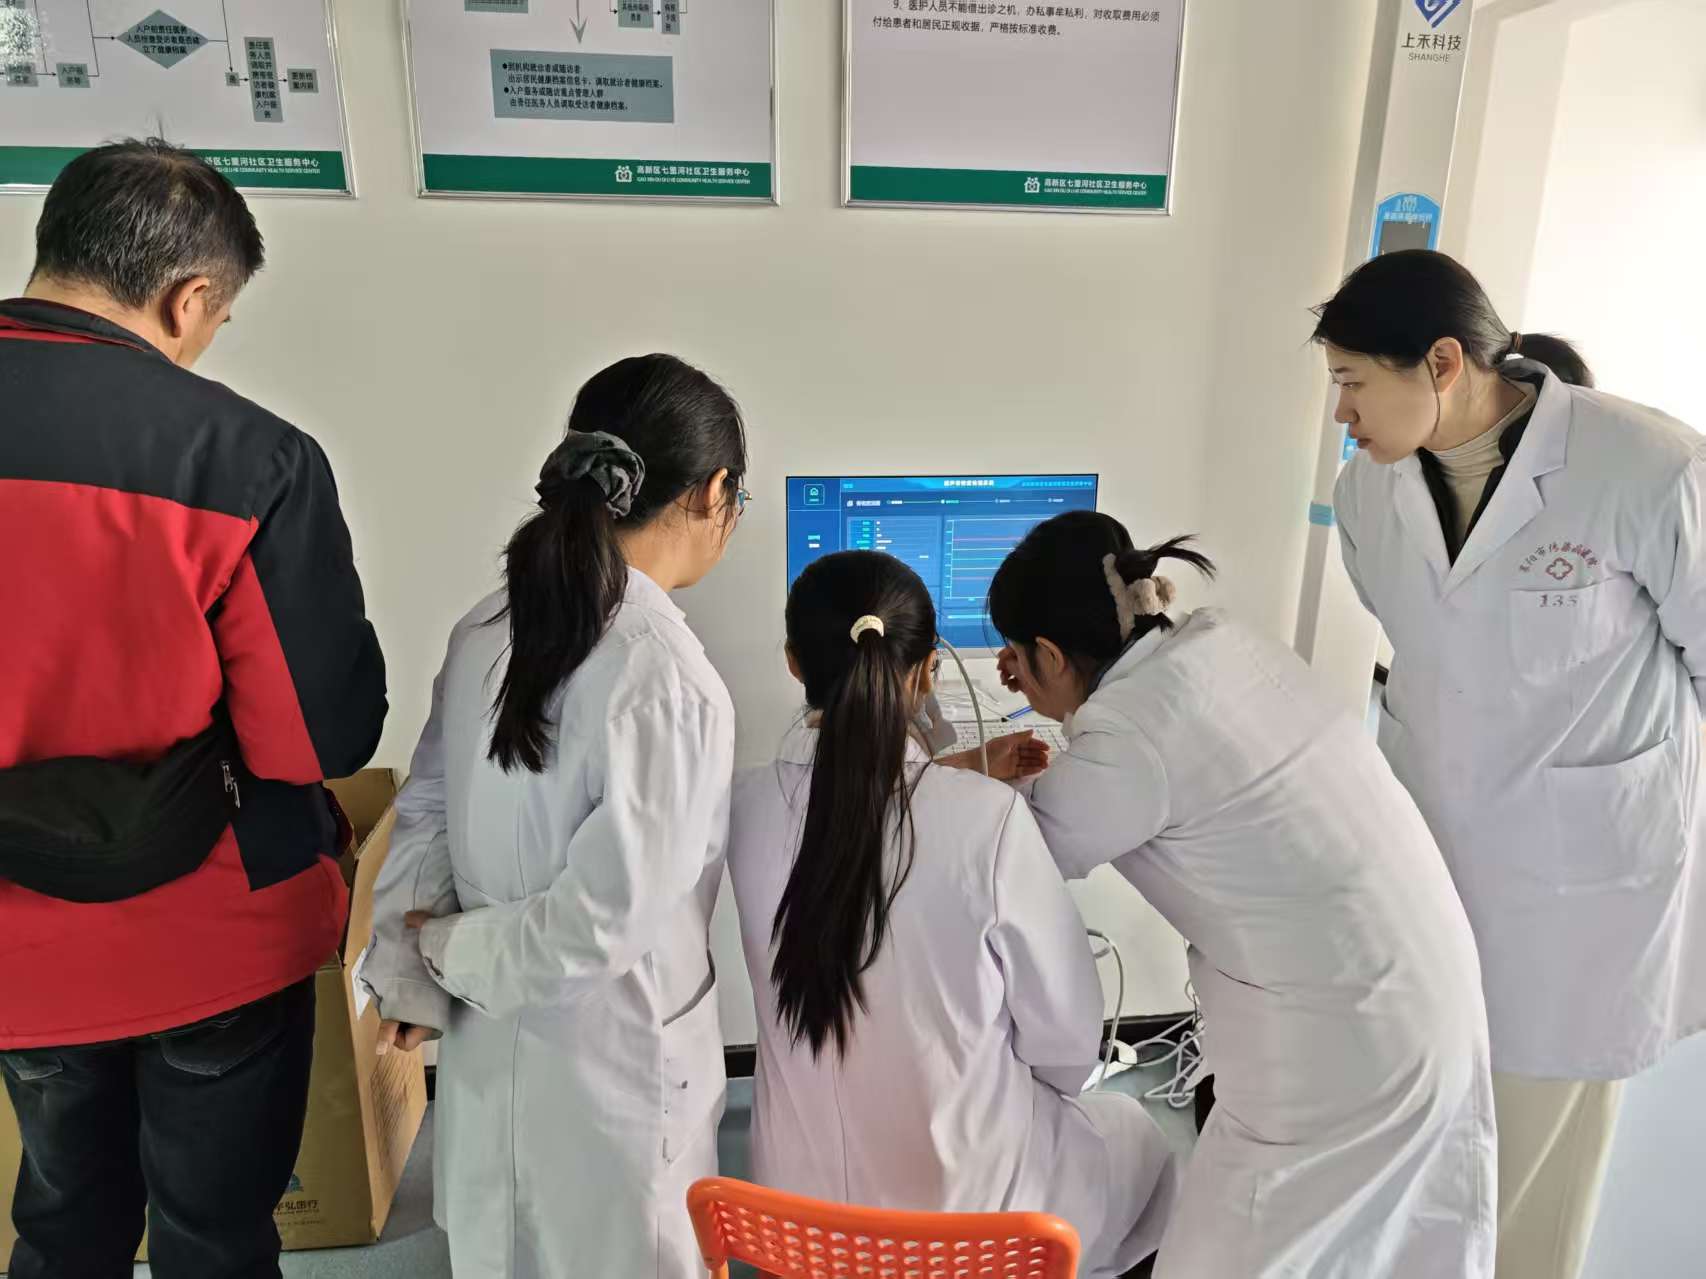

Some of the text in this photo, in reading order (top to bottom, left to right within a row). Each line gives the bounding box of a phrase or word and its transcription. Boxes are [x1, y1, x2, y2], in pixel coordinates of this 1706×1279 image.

[1401, 32, 1462, 51] 上禾科技
[1408, 52, 1449, 63] SHANGHE
